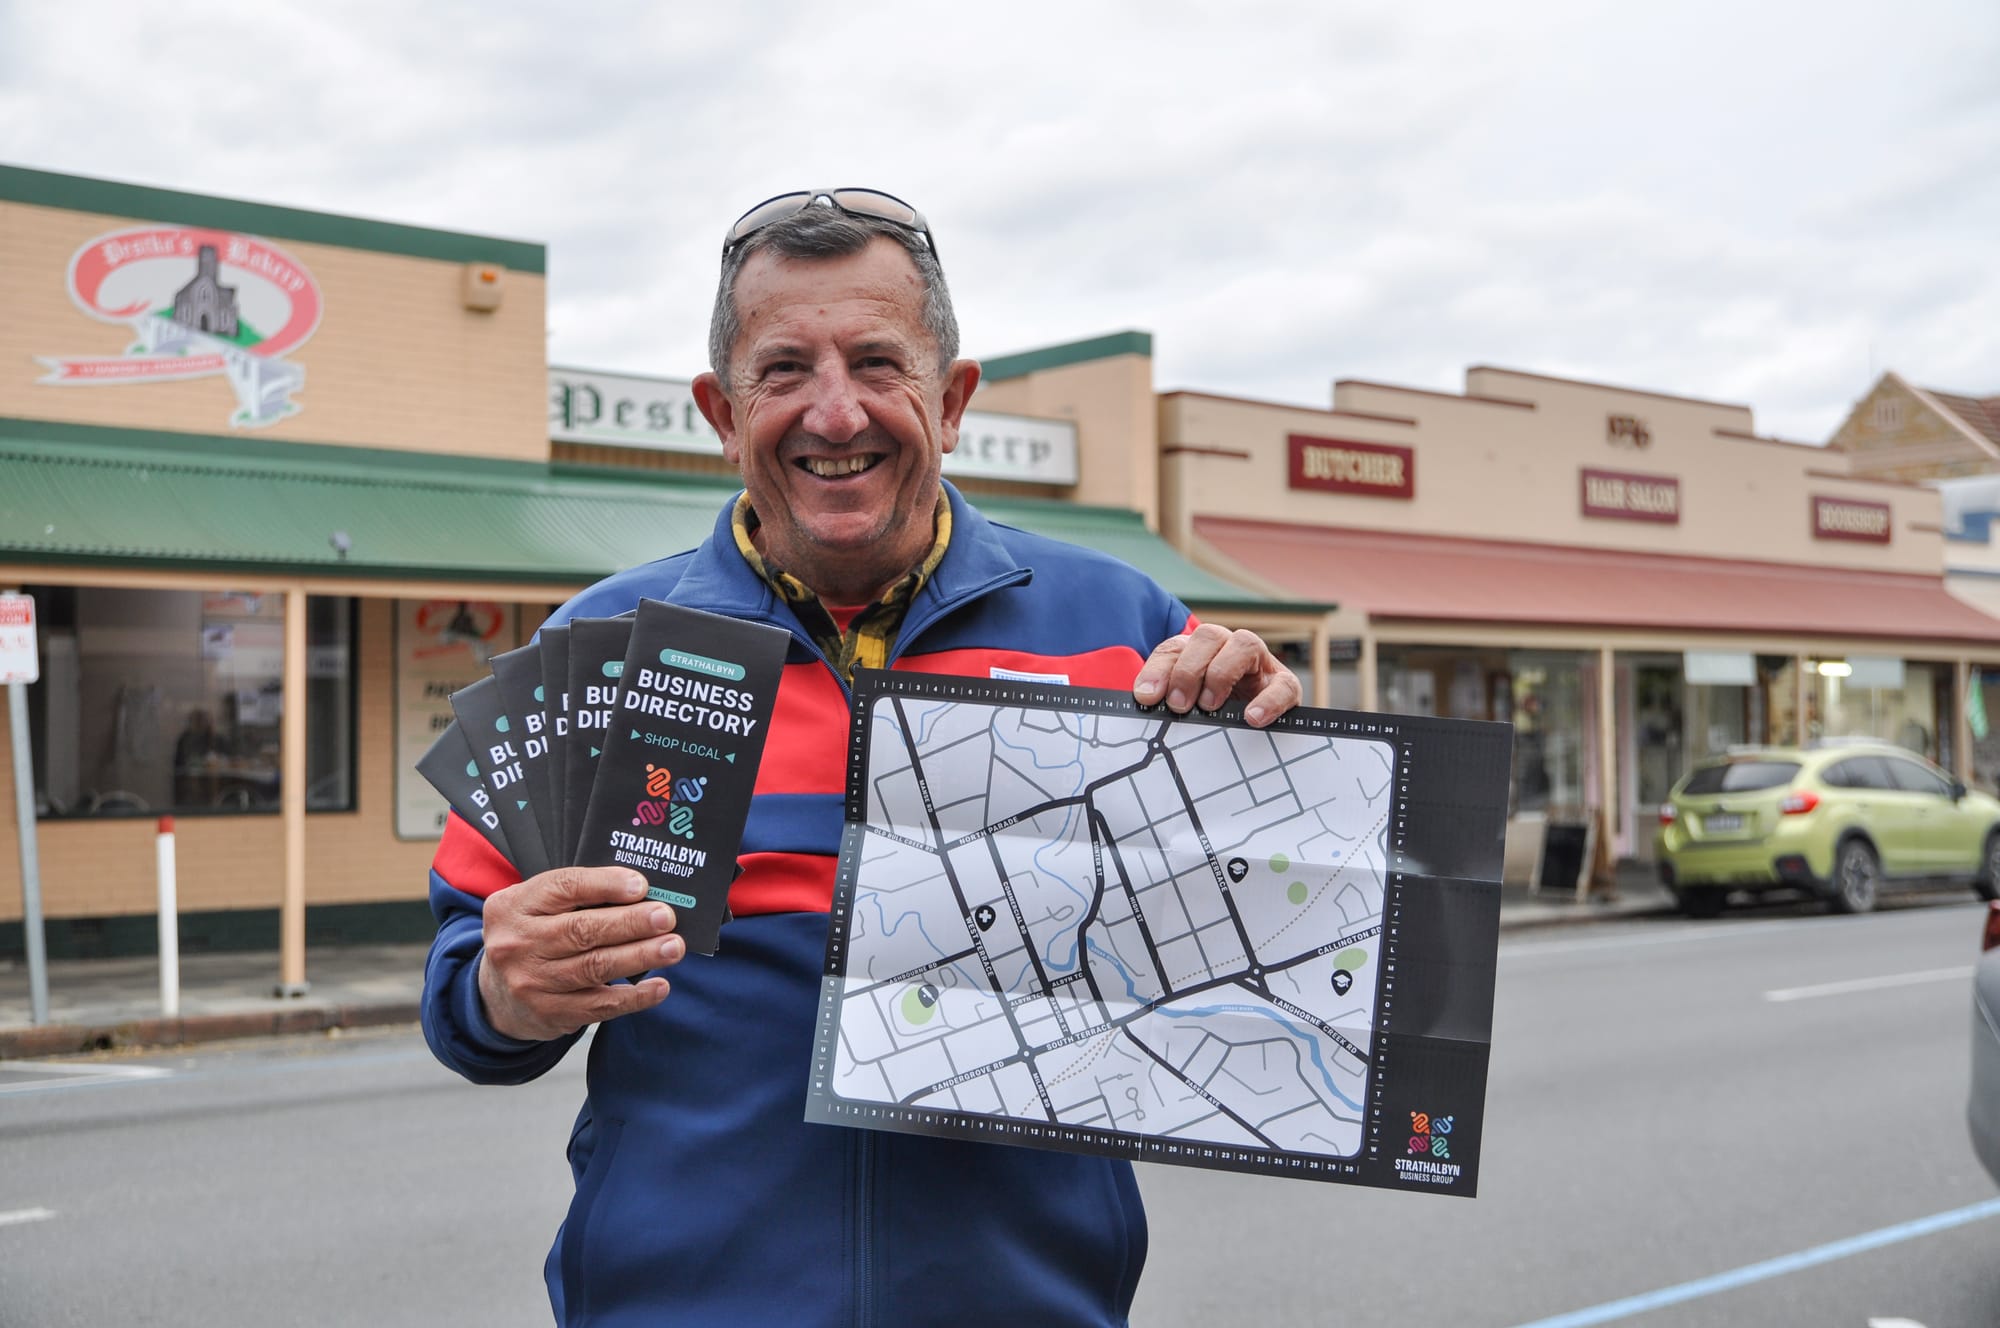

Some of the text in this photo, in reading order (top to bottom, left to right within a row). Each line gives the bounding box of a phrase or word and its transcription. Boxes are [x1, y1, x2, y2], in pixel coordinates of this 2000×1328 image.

[550, 379, 1052, 466] Pest kery
[1302, 445, 1405, 487] BUTCHER
[669, 653, 735, 678] STRATHALBYN
[637, 668, 754, 712] BUSINESS
[624, 690, 757, 738] DIRECTORY
[644, 732, 721, 762] SHOP LOCAL
[920, 779, 934, 813] MANSE RD
[874, 828, 934, 853] OLD BULL CREEK RD
[958, 816, 1018, 846] NORTH PARADE
[610, 830, 707, 868] STRATHALBYN
[614, 849, 694, 879] BUSINESS GROUP
[1200, 834, 1228, 893] EAST TERRACE
[1096, 868, 1103, 878] ST
[647, 889, 693, 906] GMAIL.COM
[1002, 881, 1028, 935] COMMERCIAL RD
[1129, 896, 1144, 923] HIGH ST
[965, 916, 995, 978] WEST TERRACE
[1318, 926, 1382, 956] CALLINGTON RD
[889, 962, 938, 985] ASHBOURNE RD
[1052, 975, 1073, 988] ALBYN
[1010, 996, 1032, 1008] ALBYN
[1046, 1022, 1112, 1051] SOUTH TERRACE
[1060, 1023, 1068, 1033] ST
[1272, 997, 1357, 1054] LANGHORNE CREEK RD
[932, 1061, 1005, 1092] SANDERGROVE RD
[1184, 1078, 1220, 1108] PARKER AVE
[1394, 1158, 1460, 1177] STRATHALBYN
[1400, 1170, 1454, 1185] BUSINESS GROUP
